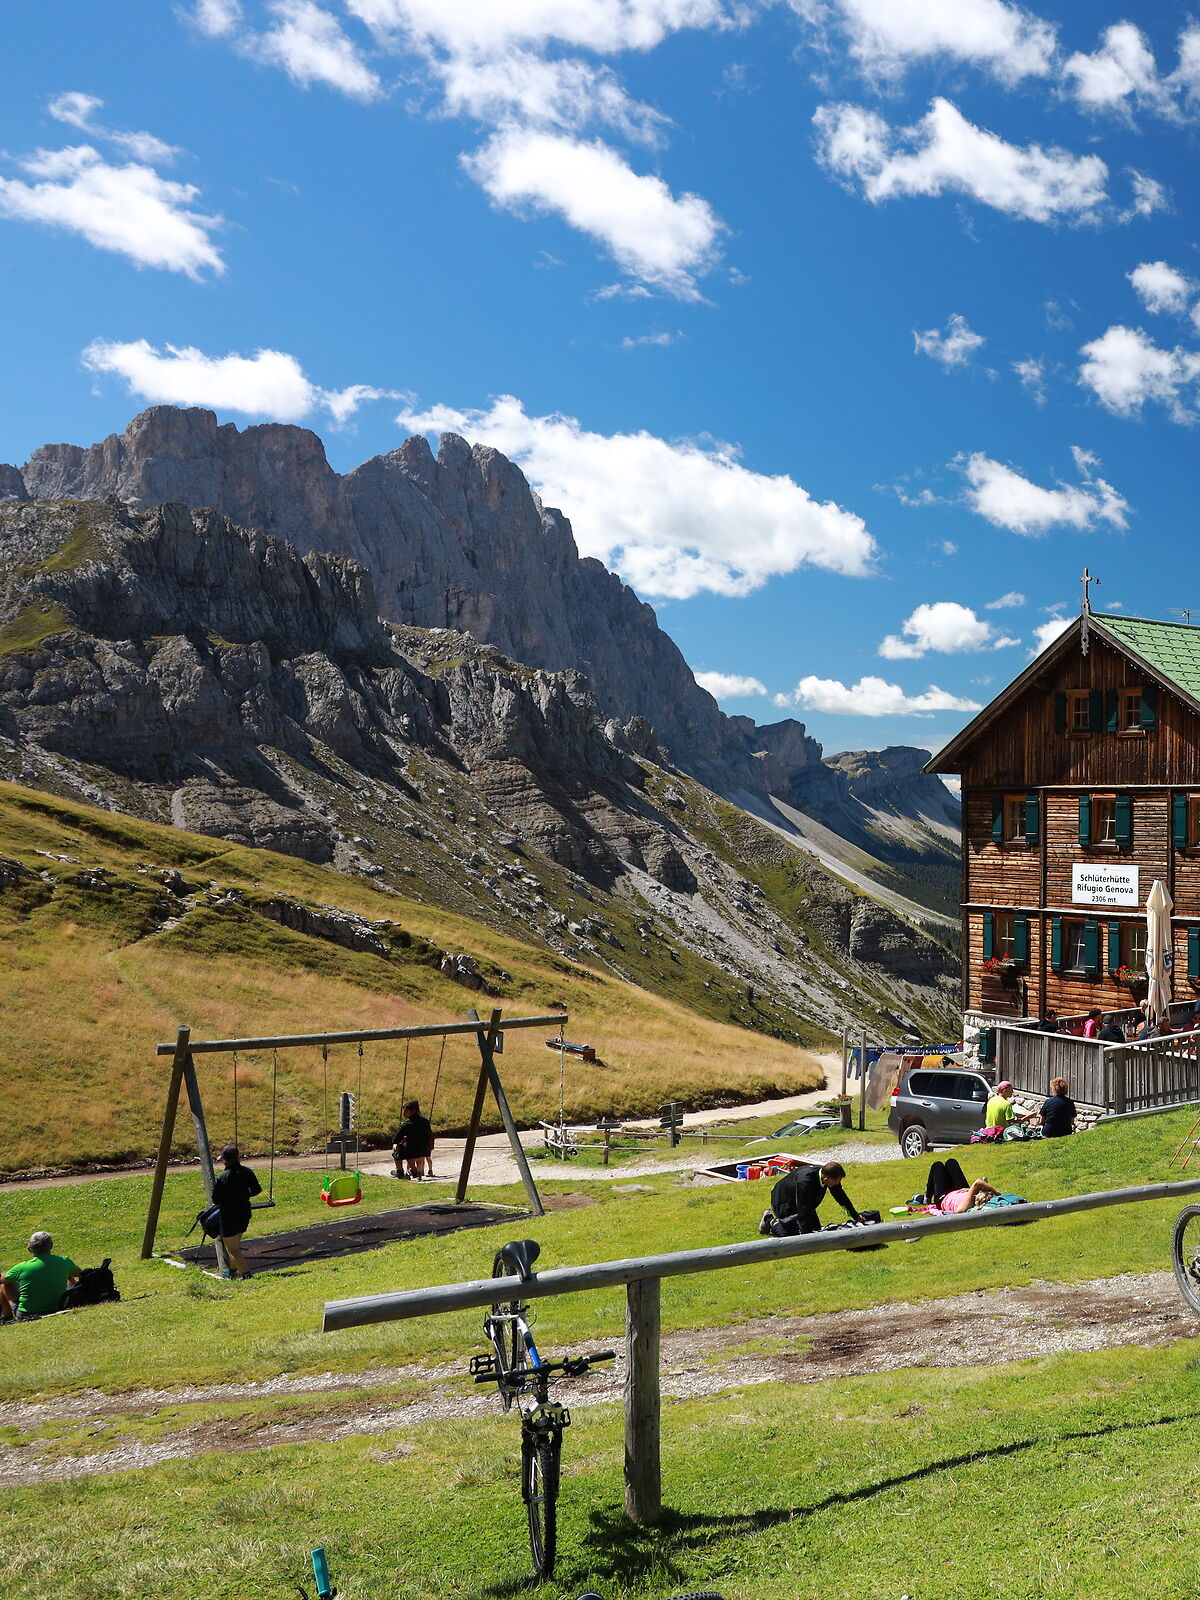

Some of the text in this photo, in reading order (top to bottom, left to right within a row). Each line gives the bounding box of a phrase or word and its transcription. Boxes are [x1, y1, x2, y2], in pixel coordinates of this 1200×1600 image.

[1080, 873, 1130, 884] Schlüterhütte
[1077, 883, 1134, 894] Rifugio Genova
[1091, 895, 1107, 903] 2306
